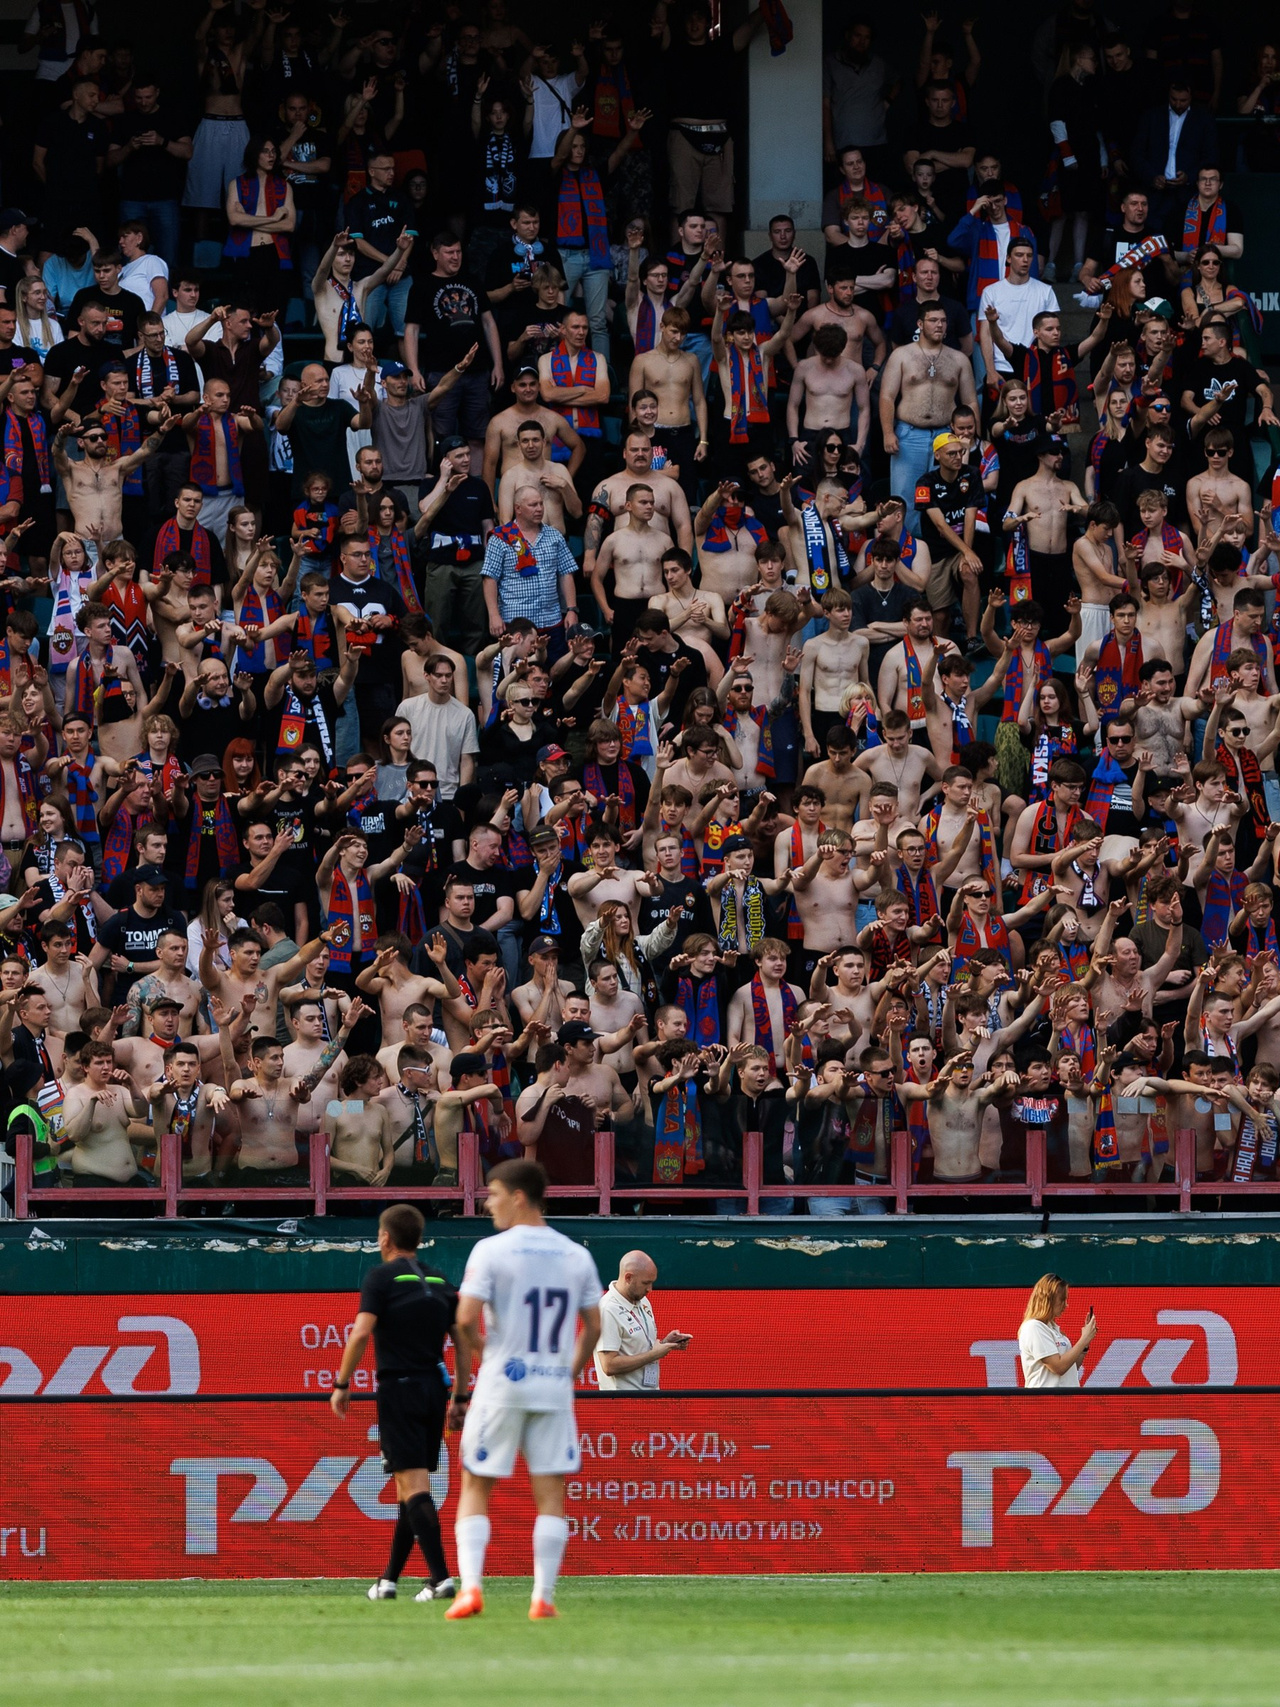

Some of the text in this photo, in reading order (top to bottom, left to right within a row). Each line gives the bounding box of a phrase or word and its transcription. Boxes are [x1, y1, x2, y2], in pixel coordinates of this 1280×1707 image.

[1033, 734, 1049, 784] CSKA
[1111, 803, 1132, 811] Columbi
[659, 909, 694, 920] РОЕТИ
[525, 1287, 569, 1354] 17
[578, 1433, 618, 1458] АО
[631, 1432, 738, 1462] «РЖД»
[566, 1474, 895, 1506] енеральный спонсор
[613, 1515, 823, 1541] «Локомотив»
